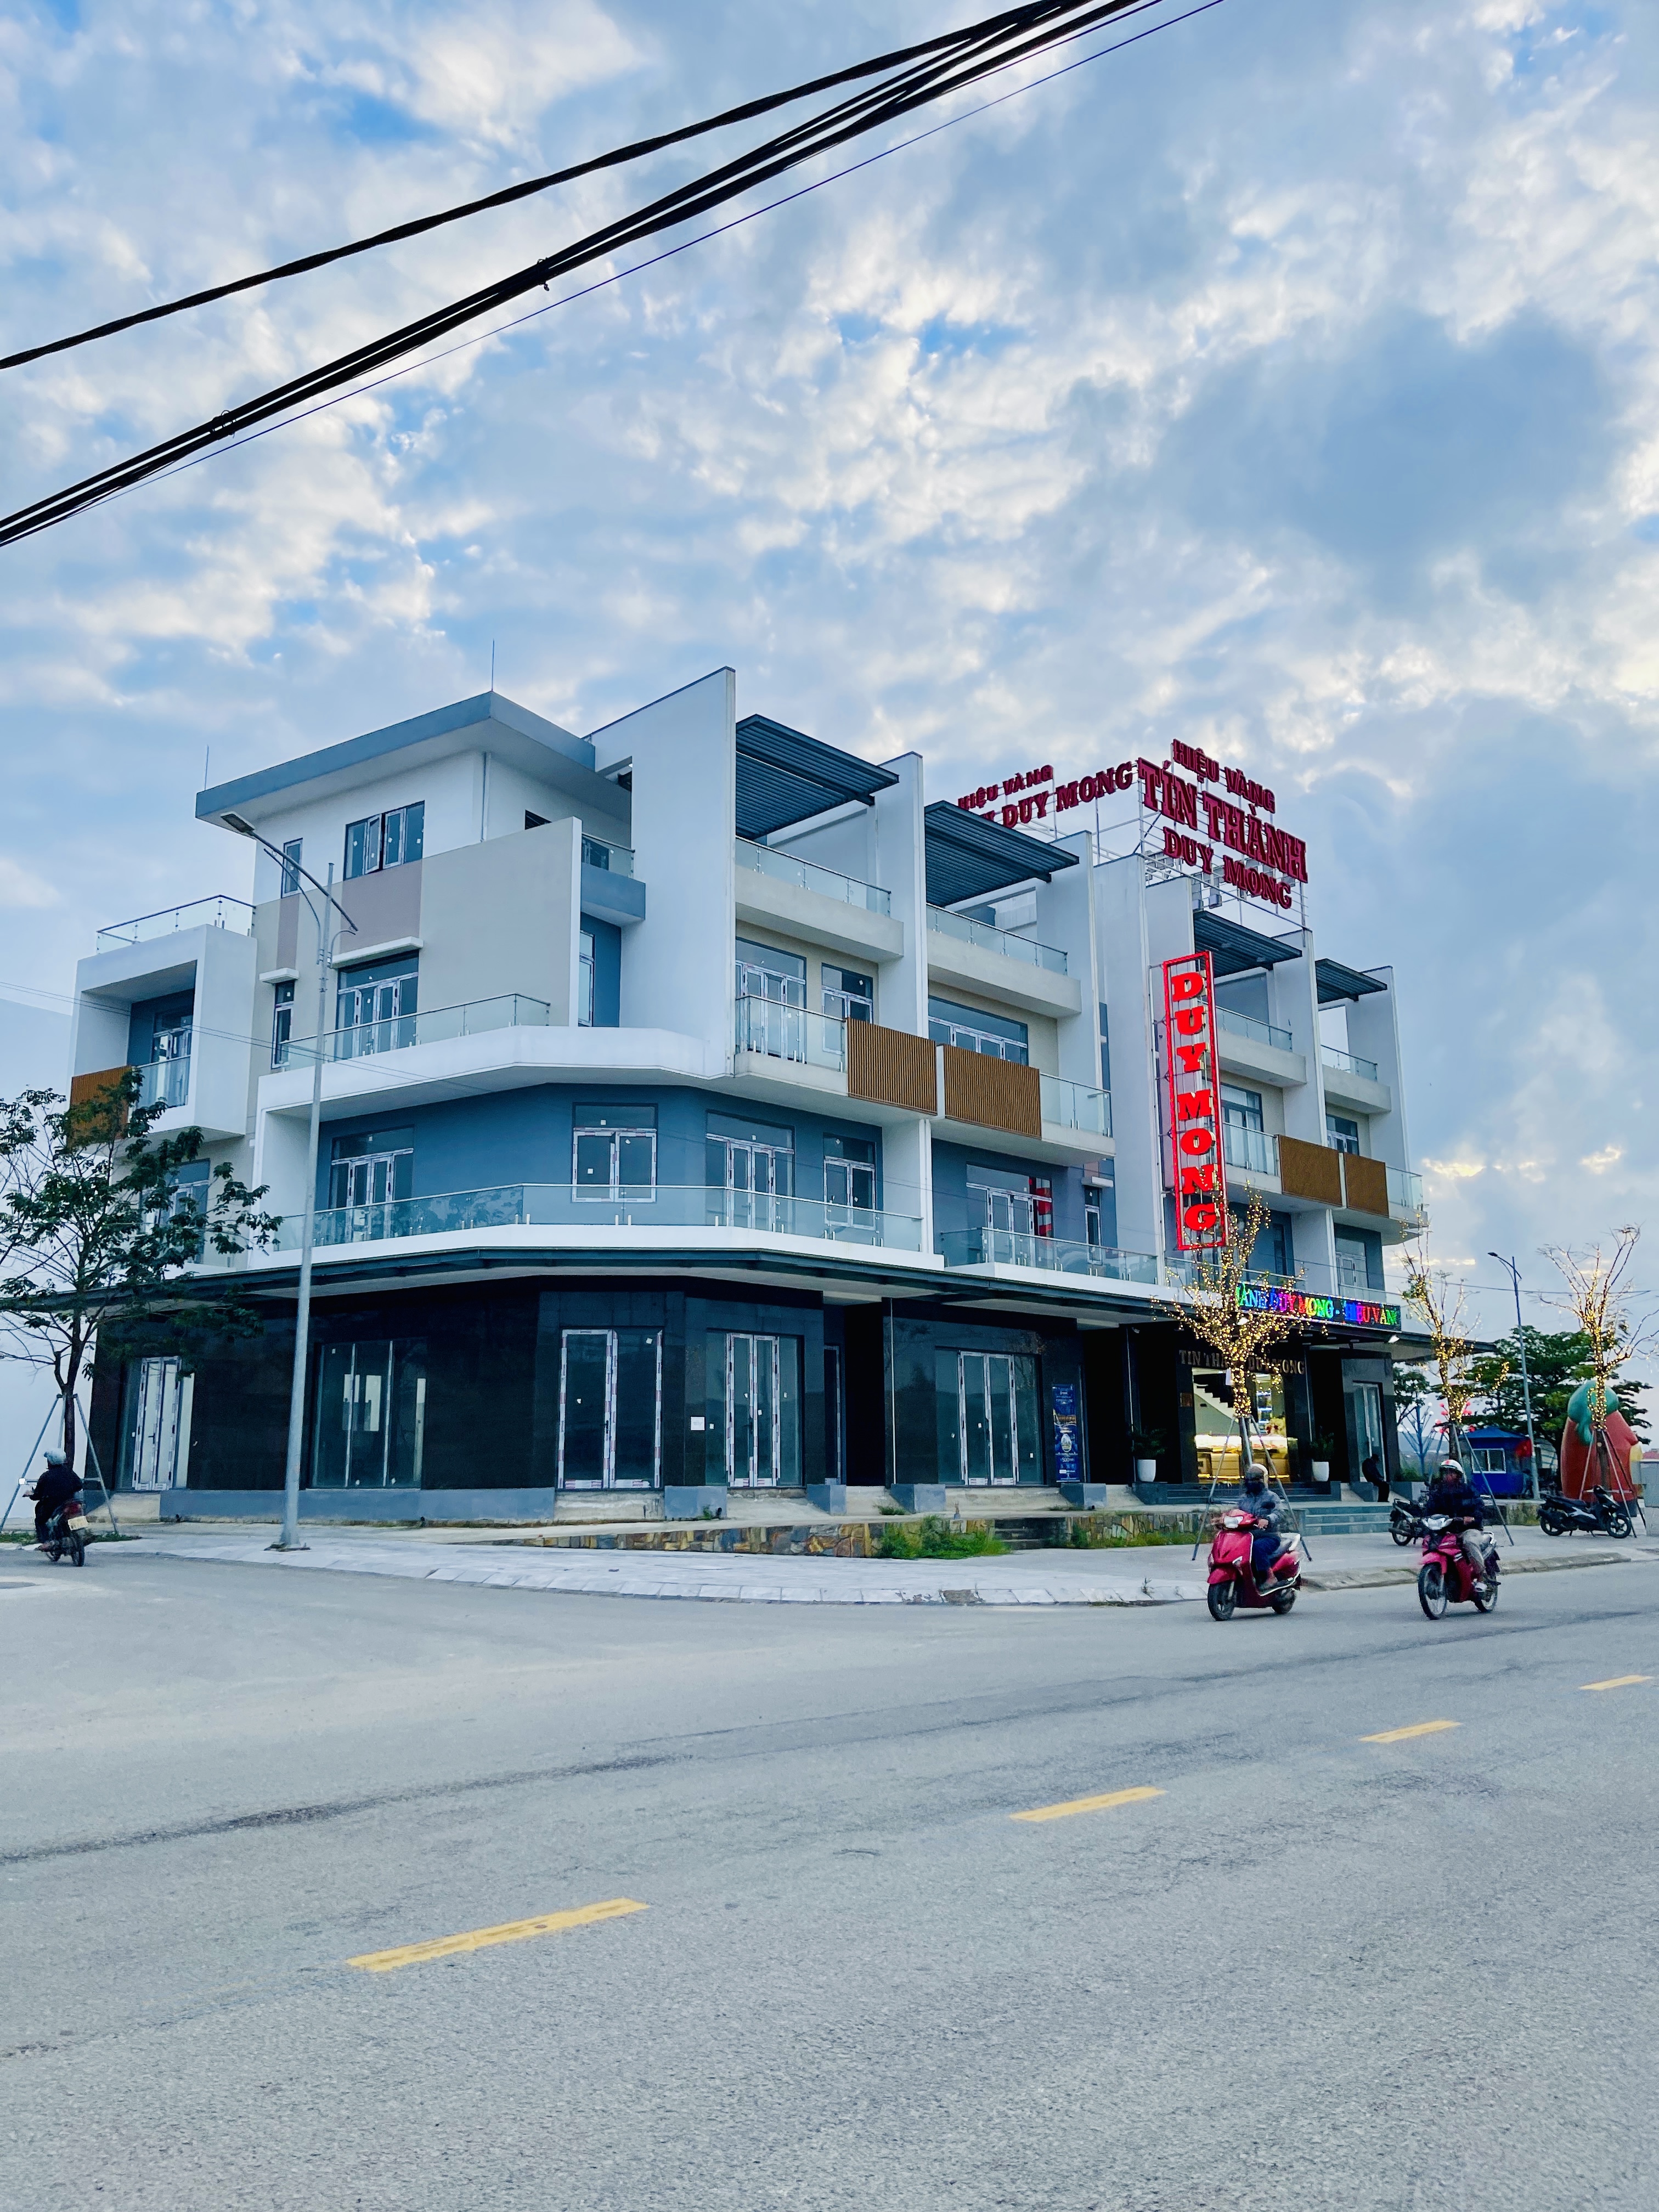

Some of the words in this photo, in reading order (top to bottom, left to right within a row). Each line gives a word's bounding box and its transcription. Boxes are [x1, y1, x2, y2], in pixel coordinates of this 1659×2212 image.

[1002, 765, 1053, 795] VÀNG
[1002, 791, 1049, 828] DUY
[1055, 761, 1133, 812] MONG
[1173, 739, 1220, 783] HIỆU
[1224, 767, 1276, 814] VÀNG
[1137, 758, 1198, 830] TÍN
[1202, 791, 1308, 883] THÀNH
[1163, 826, 1213, 875] DUY
[1223, 855, 1291, 909] MONG
[1171, 971, 1209, 1072] DUY
[1177, 1088, 1218, 1231] MONG
